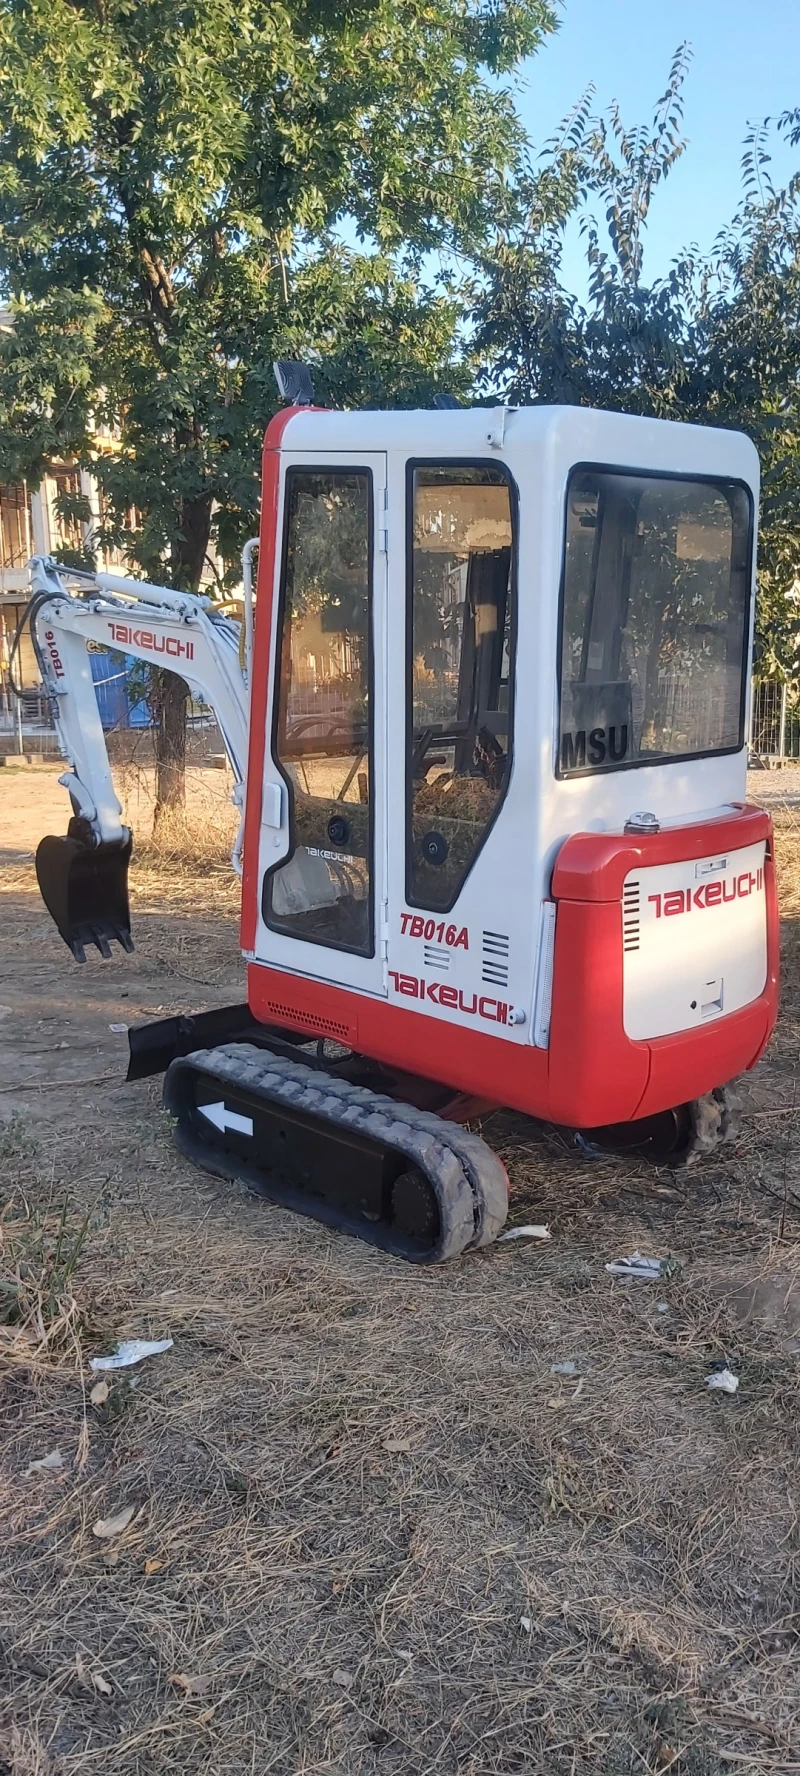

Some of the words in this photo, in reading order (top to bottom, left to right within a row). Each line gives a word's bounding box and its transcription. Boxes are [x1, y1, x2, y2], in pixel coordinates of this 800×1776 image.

[44, 630, 66, 680] TB016
[560, 724, 628, 771] MSU
[400, 912, 470, 951] TB016A
